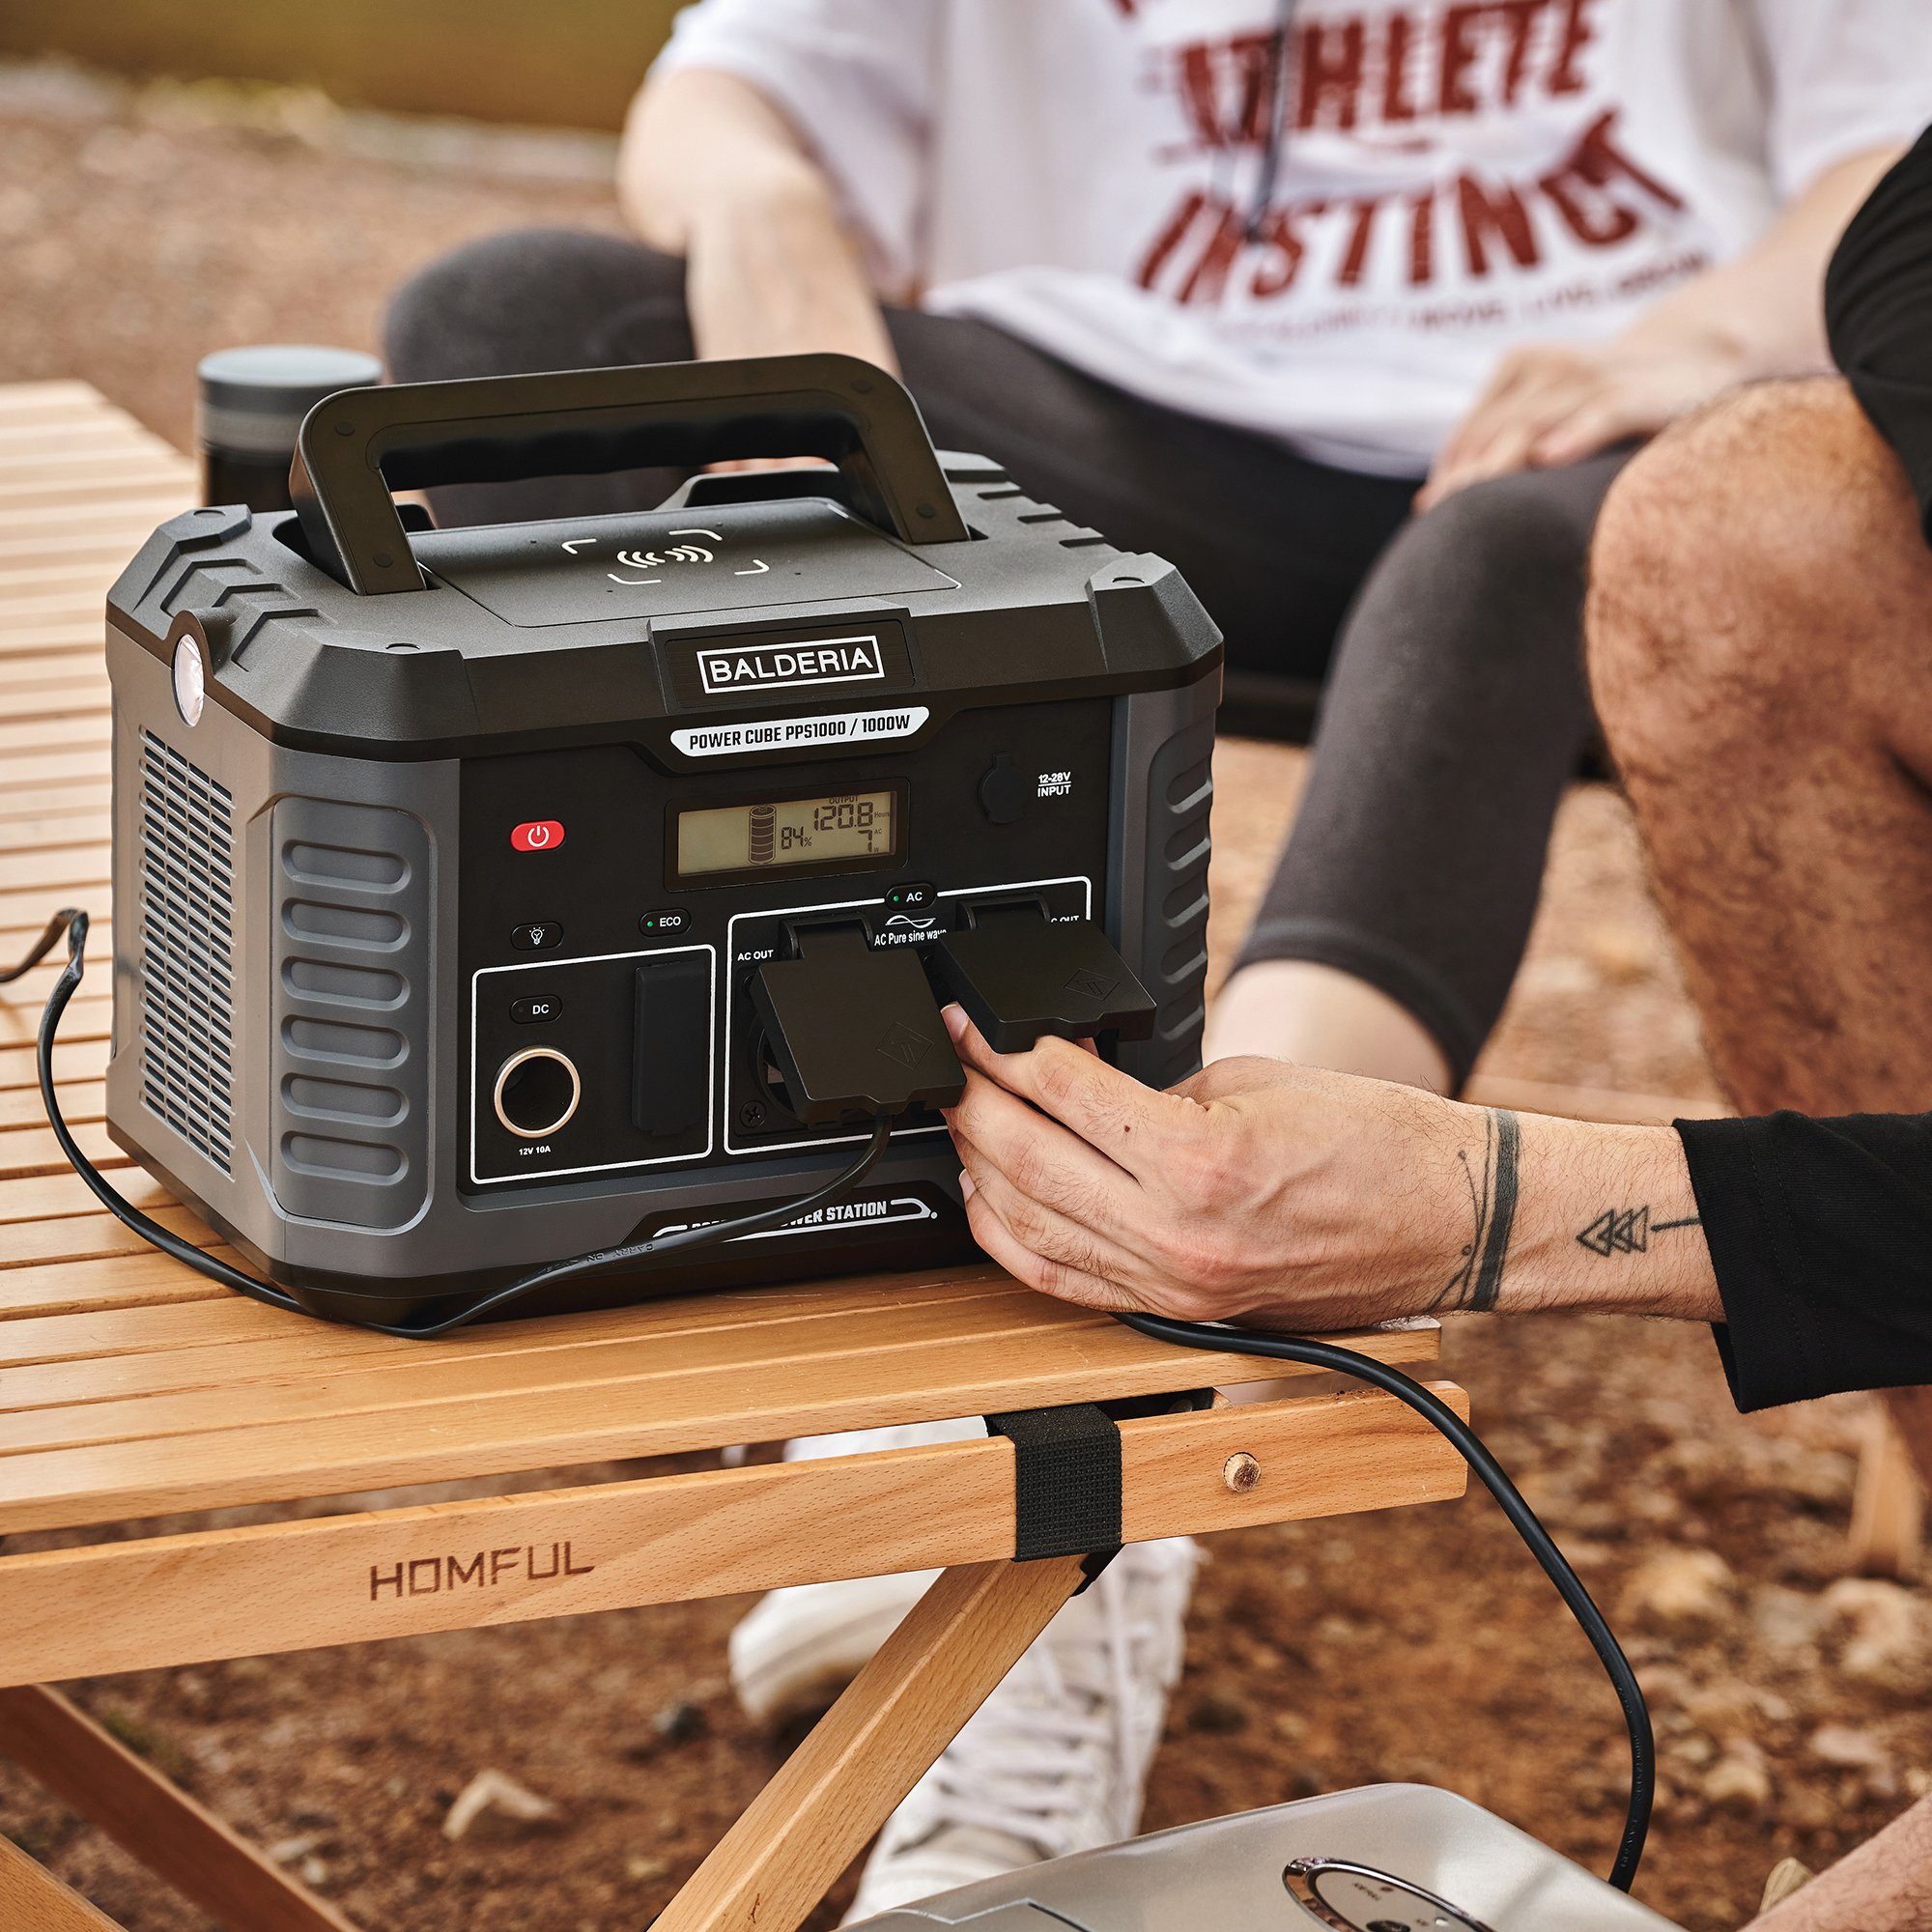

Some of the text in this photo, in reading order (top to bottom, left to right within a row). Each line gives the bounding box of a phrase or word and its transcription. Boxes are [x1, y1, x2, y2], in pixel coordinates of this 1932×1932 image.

[709, 646, 874, 683] BALDERIA
[689, 730, 742, 751] POWER
[745, 726, 782, 745] CUBE
[785, 721, 846, 741] PPS1000
[862, 714, 911, 733] 1000W
[1037, 771, 1071, 784] 12-28V
[1037, 784, 1071, 798] INPUT
[829, 795, 859, 805] OUTPUT
[813, 801, 873, 832] 120.8
[905, 891, 923, 903] AC
[659, 916, 682, 927] ECO
[873, 932, 887, 947] AC
[888, 932, 907, 945] Pure
[908, 929, 925, 943] sine
[737, 949, 775, 962] AC OUT
[532, 1004, 551, 1015] DC
[518, 1144, 552, 1156] 12V 10A
[826, 1200, 887, 1222] STATION
[370, 1541, 596, 1601] HOMFUL
